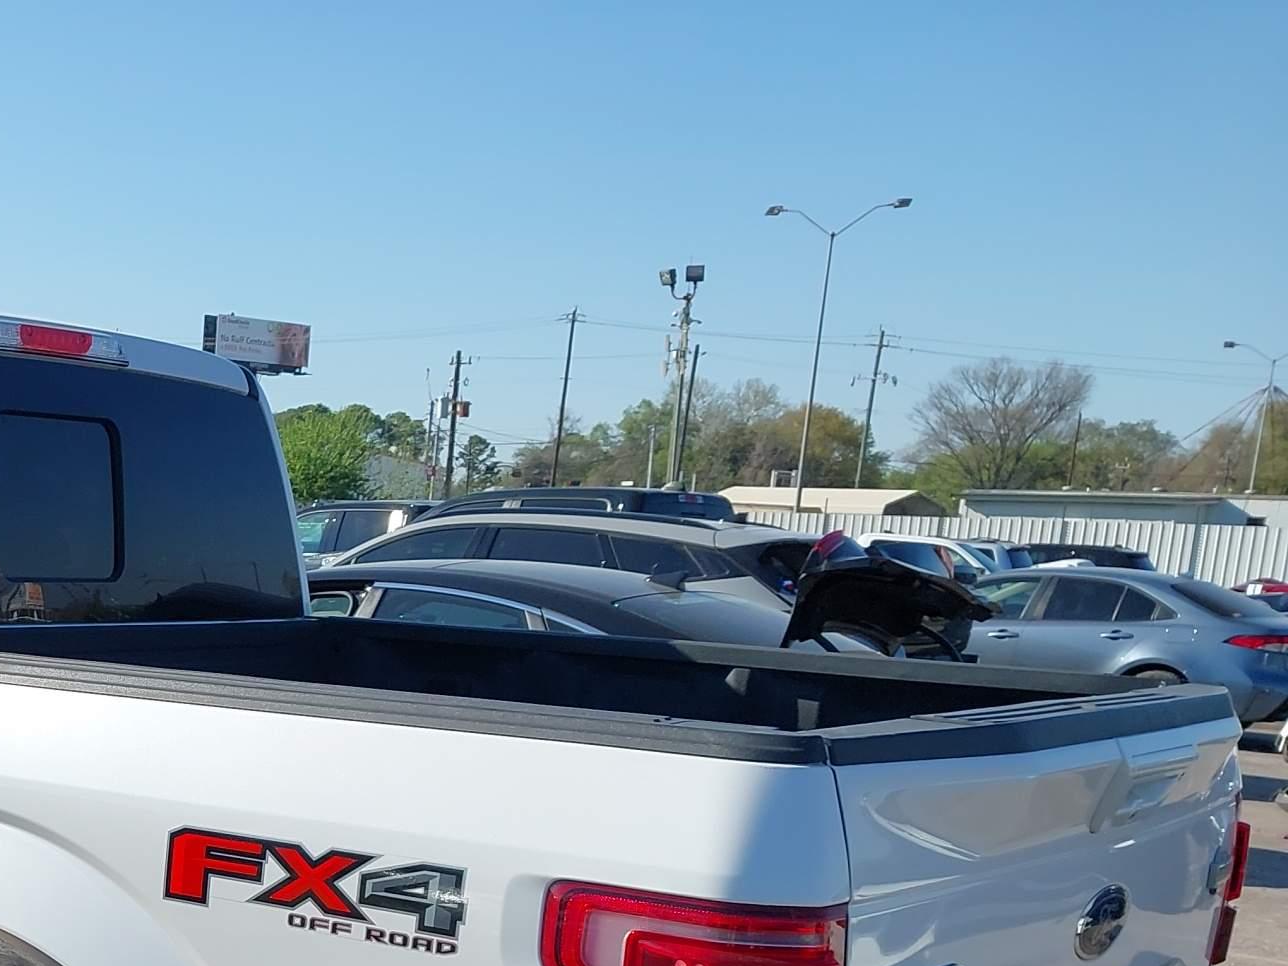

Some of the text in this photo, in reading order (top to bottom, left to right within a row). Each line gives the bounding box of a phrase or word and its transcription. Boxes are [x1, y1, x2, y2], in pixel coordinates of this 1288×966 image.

[162, 824, 469, 941] FX4
[287, 911, 460, 957] OFF ROAD
